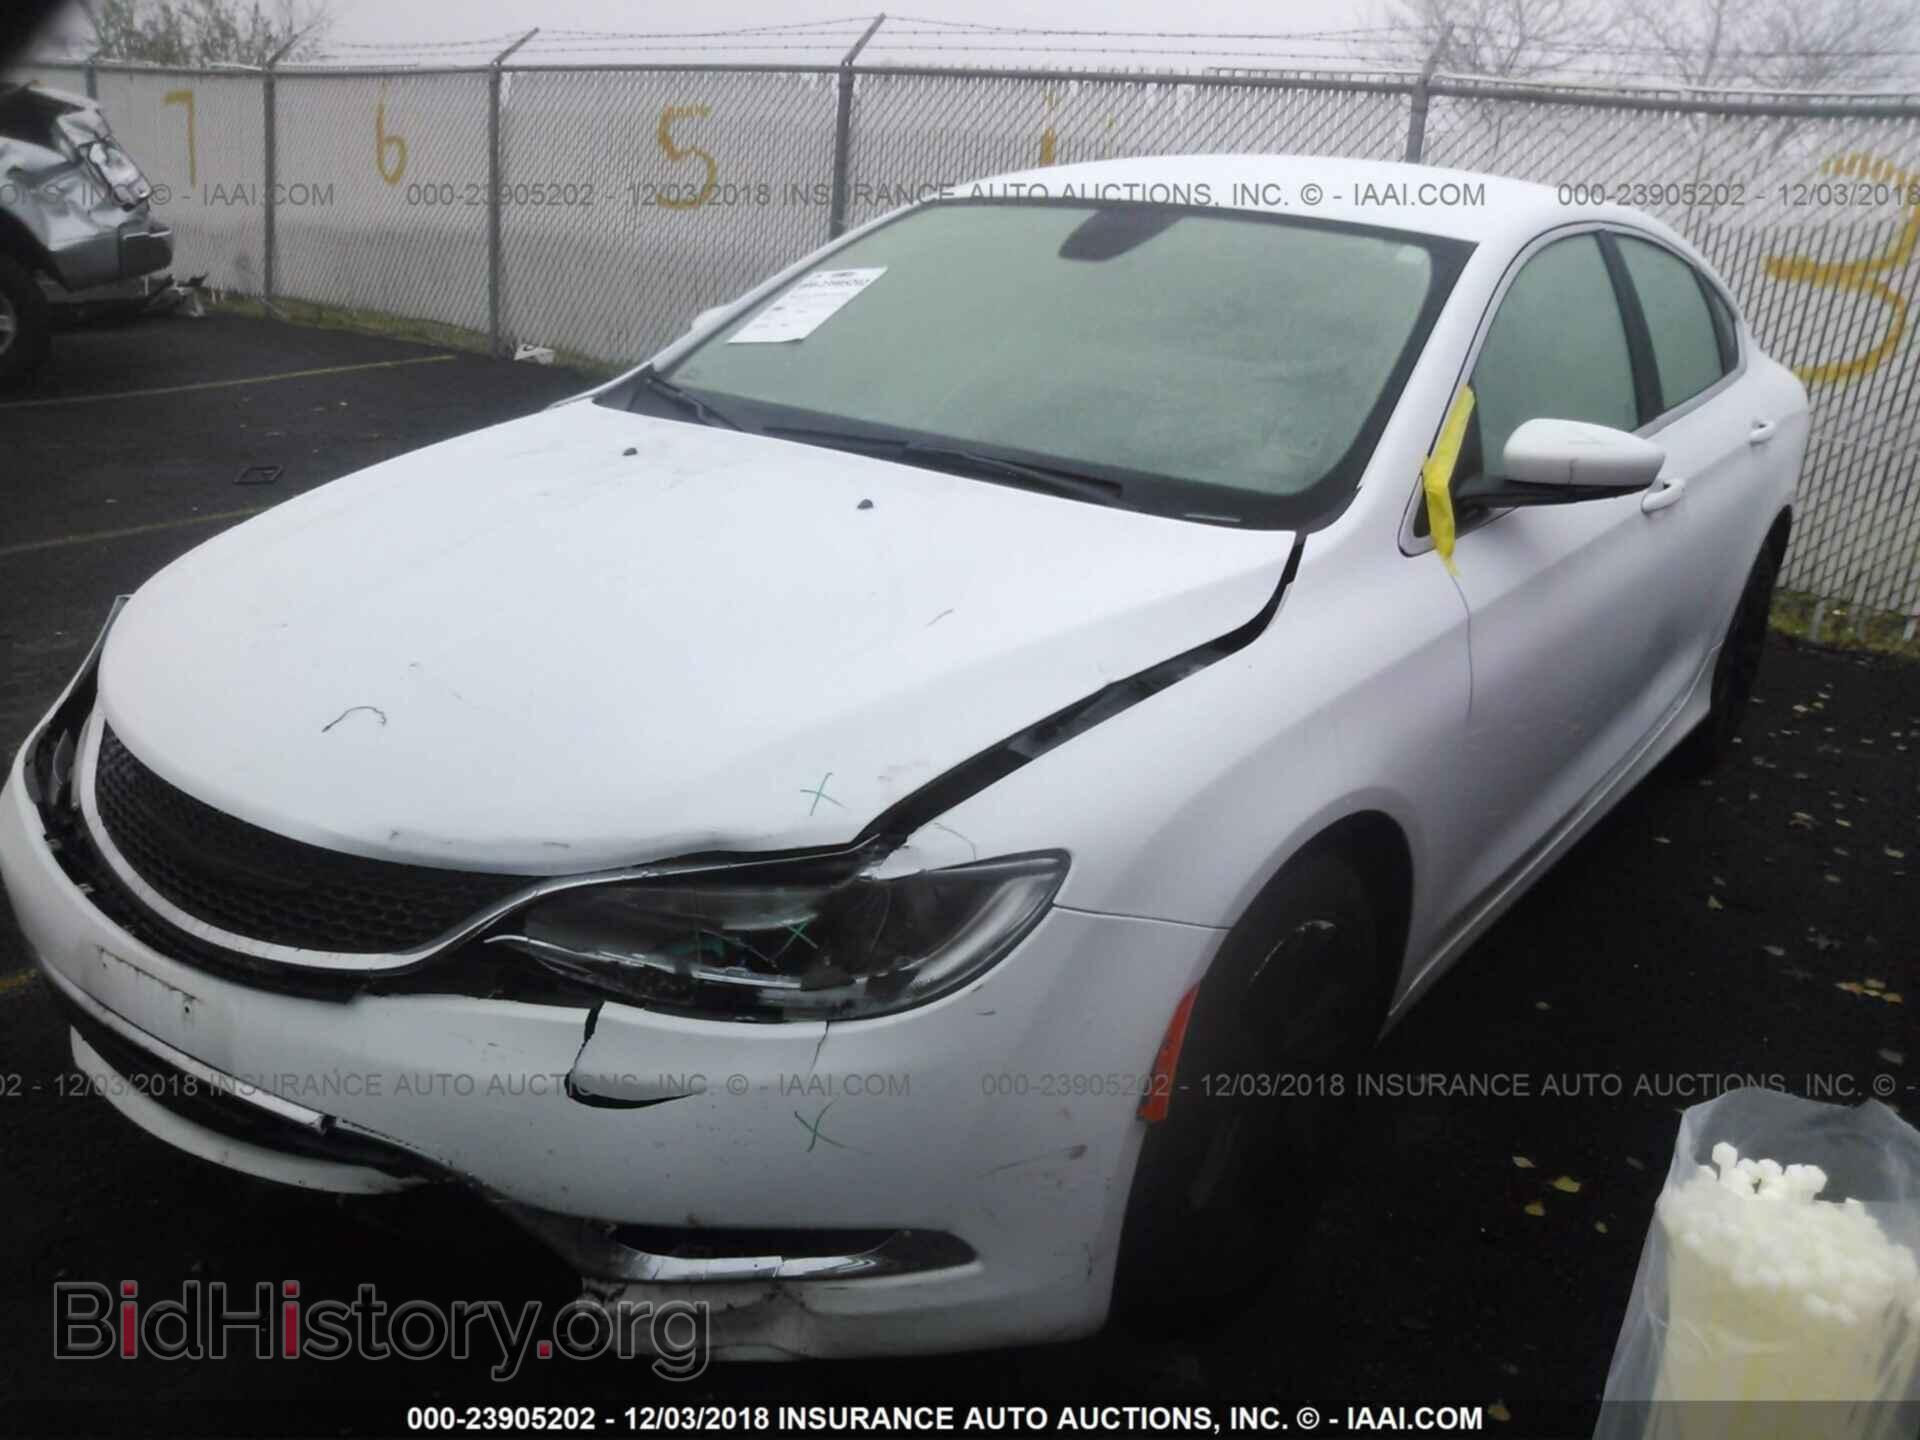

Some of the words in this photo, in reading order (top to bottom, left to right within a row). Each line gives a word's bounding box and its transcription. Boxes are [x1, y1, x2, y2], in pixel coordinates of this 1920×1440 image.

[163, 90, 196, 188] 7
[375, 80, 408, 185] 6
[656, 103, 718, 210] 5
[1759, 152, 1920, 383] 3
